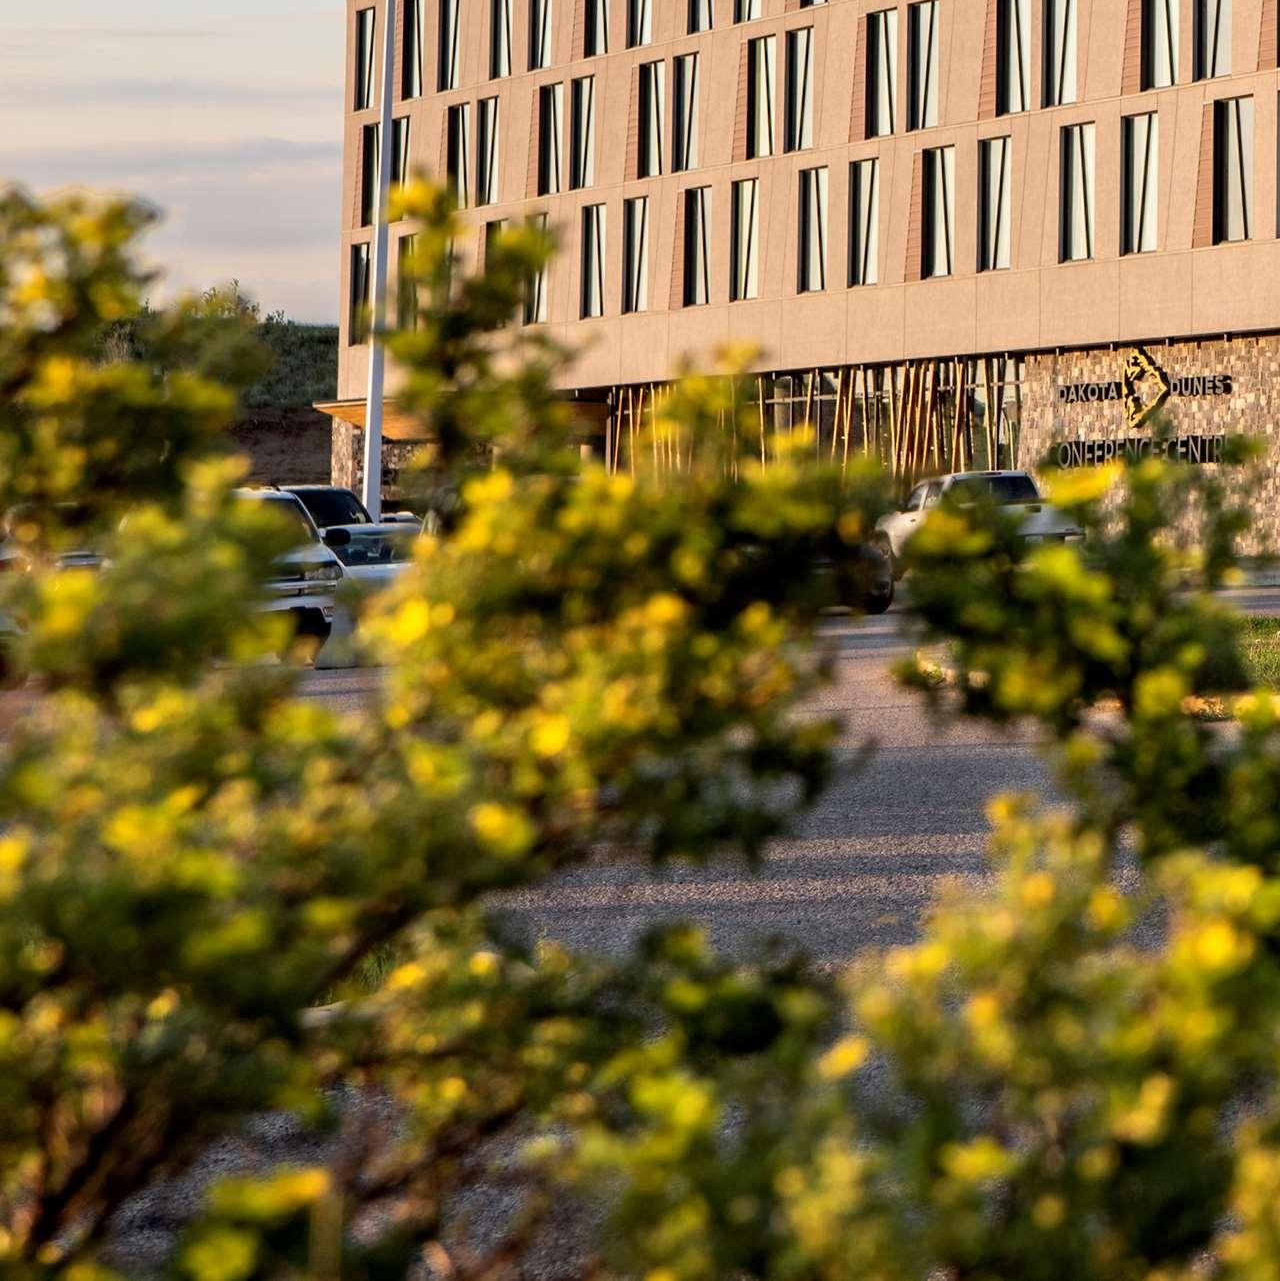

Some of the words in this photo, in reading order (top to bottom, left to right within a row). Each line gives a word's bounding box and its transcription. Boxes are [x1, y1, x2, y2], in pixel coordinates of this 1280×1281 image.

[1058, 382, 1118, 402] DAKOTA
[1170, 375, 1224, 396] DUNES
[1049, 437, 1161, 469] ONFERENCE
